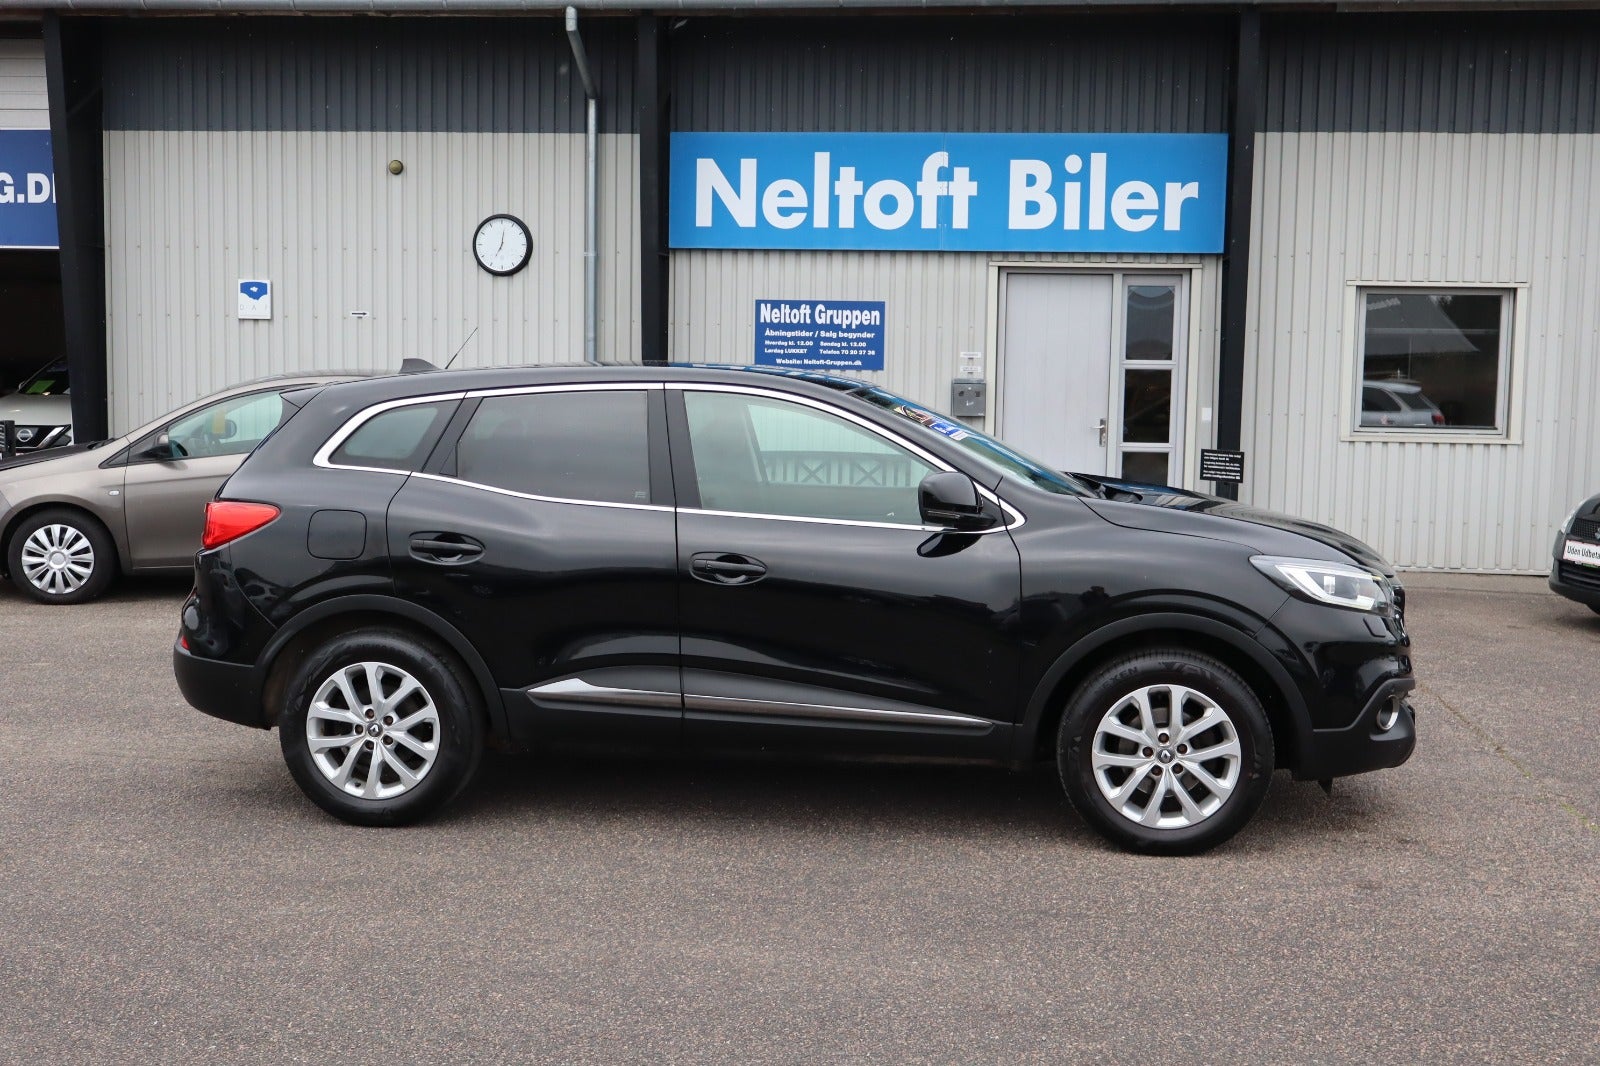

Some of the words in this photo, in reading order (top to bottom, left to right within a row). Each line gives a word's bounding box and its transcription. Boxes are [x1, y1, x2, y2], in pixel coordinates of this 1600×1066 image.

[0, 172, 56, 203] G.D
[695, 151, 978, 229] Neltoft
[1008, 152, 1199, 231] Biler
[760, 303, 811, 324] Neltoft
[815, 304, 880, 329] Gruppen
[764, 328, 813, 338] Åbningstider
[838, 330, 876, 339] begynder
